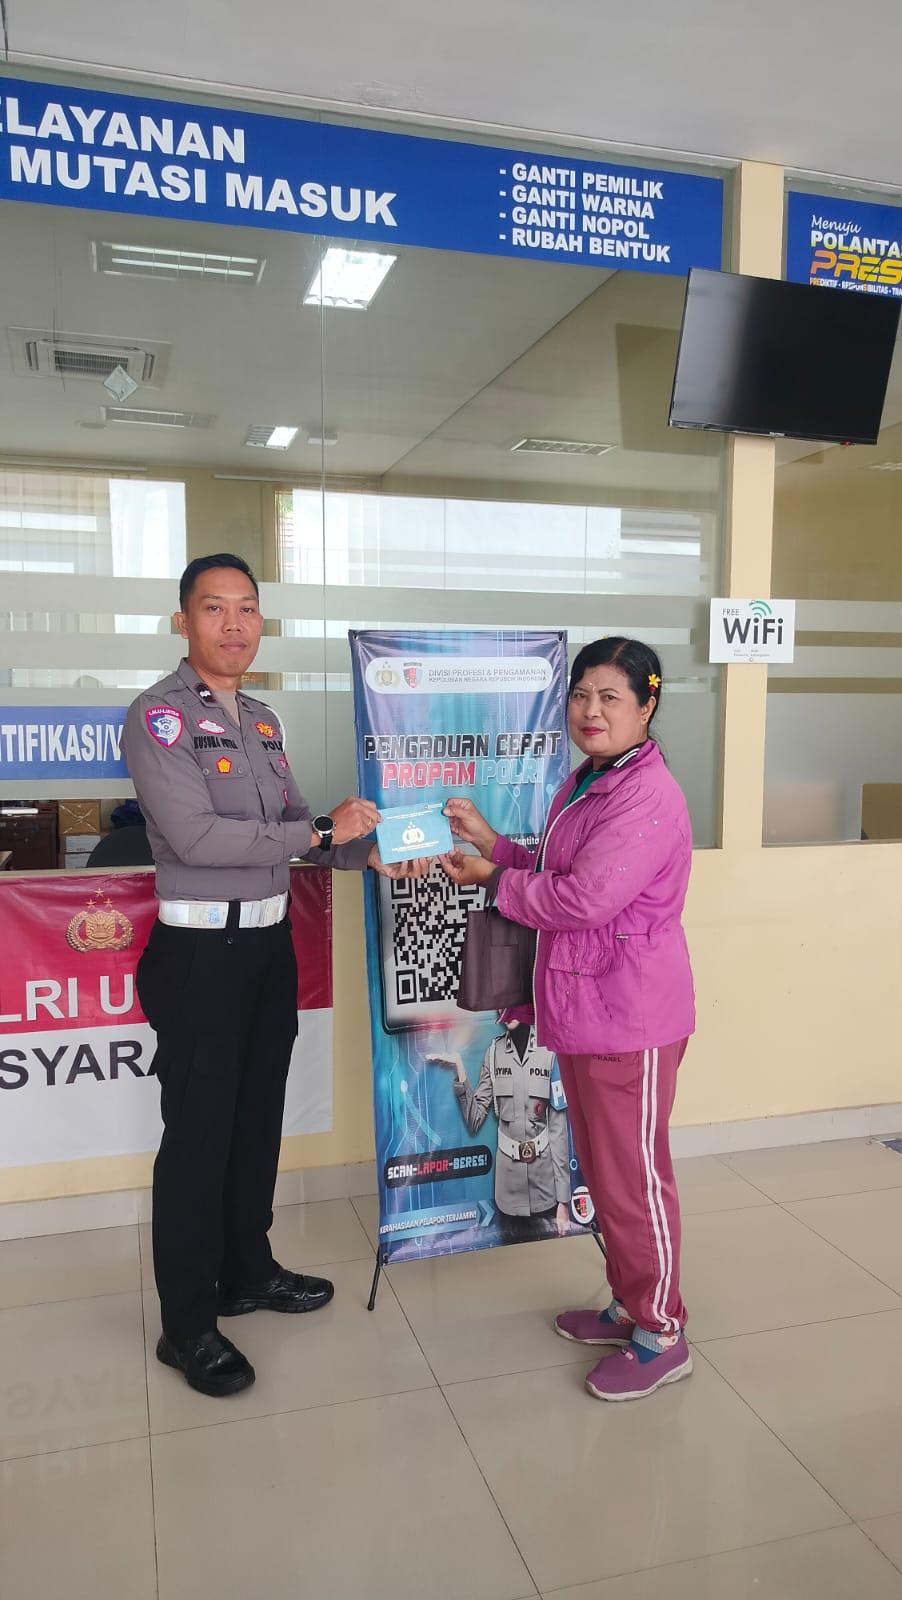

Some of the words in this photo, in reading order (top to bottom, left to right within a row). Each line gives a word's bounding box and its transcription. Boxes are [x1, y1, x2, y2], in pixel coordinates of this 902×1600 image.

[0, 96, 245, 164] LAYANAN
[10, 145, 206, 204] MUTASI
[225, 173, 399, 227] MASUK
[512, 162, 576, 188] GANTI
[582, 172, 664, 200] PEMILIK
[512, 185, 576, 210] GANTI
[582, 193, 655, 219] WARNA
[512, 206, 576, 231] GANTI
[582, 214, 650, 240] NOPOL
[811, 214, 862, 236] Menuju
[512, 228, 583, 253] RUBAH
[589, 236, 671, 263] BENTUK
[810, 230, 902, 258] POLANTA
[810, 249, 902, 285] PRES
[809, 277, 838, 288] PREDIKTIF
[841, 280, 889, 294] RESPONSIBILITAS
[722, 608, 740, 616] FREE
[722, 617, 784, 645] WiFi
[429, 668, 451, 677] DIVISI
[453, 668, 486, 677] PROFESI
[486, 668, 492, 677] &
[494, 667, 546, 677] PENGAMANAN
[0, 723, 124, 762] TIFIKASI/V
[364, 733, 490, 761] PENGADUAN
[495, 731, 562, 758] CEPAT
[382, 760, 476, 789] PROPAM
[481, 757, 545, 786] POLRI
[529, 1067, 550, 1078] POLRI
[419, 1215, 446, 1227] PELAPOR
